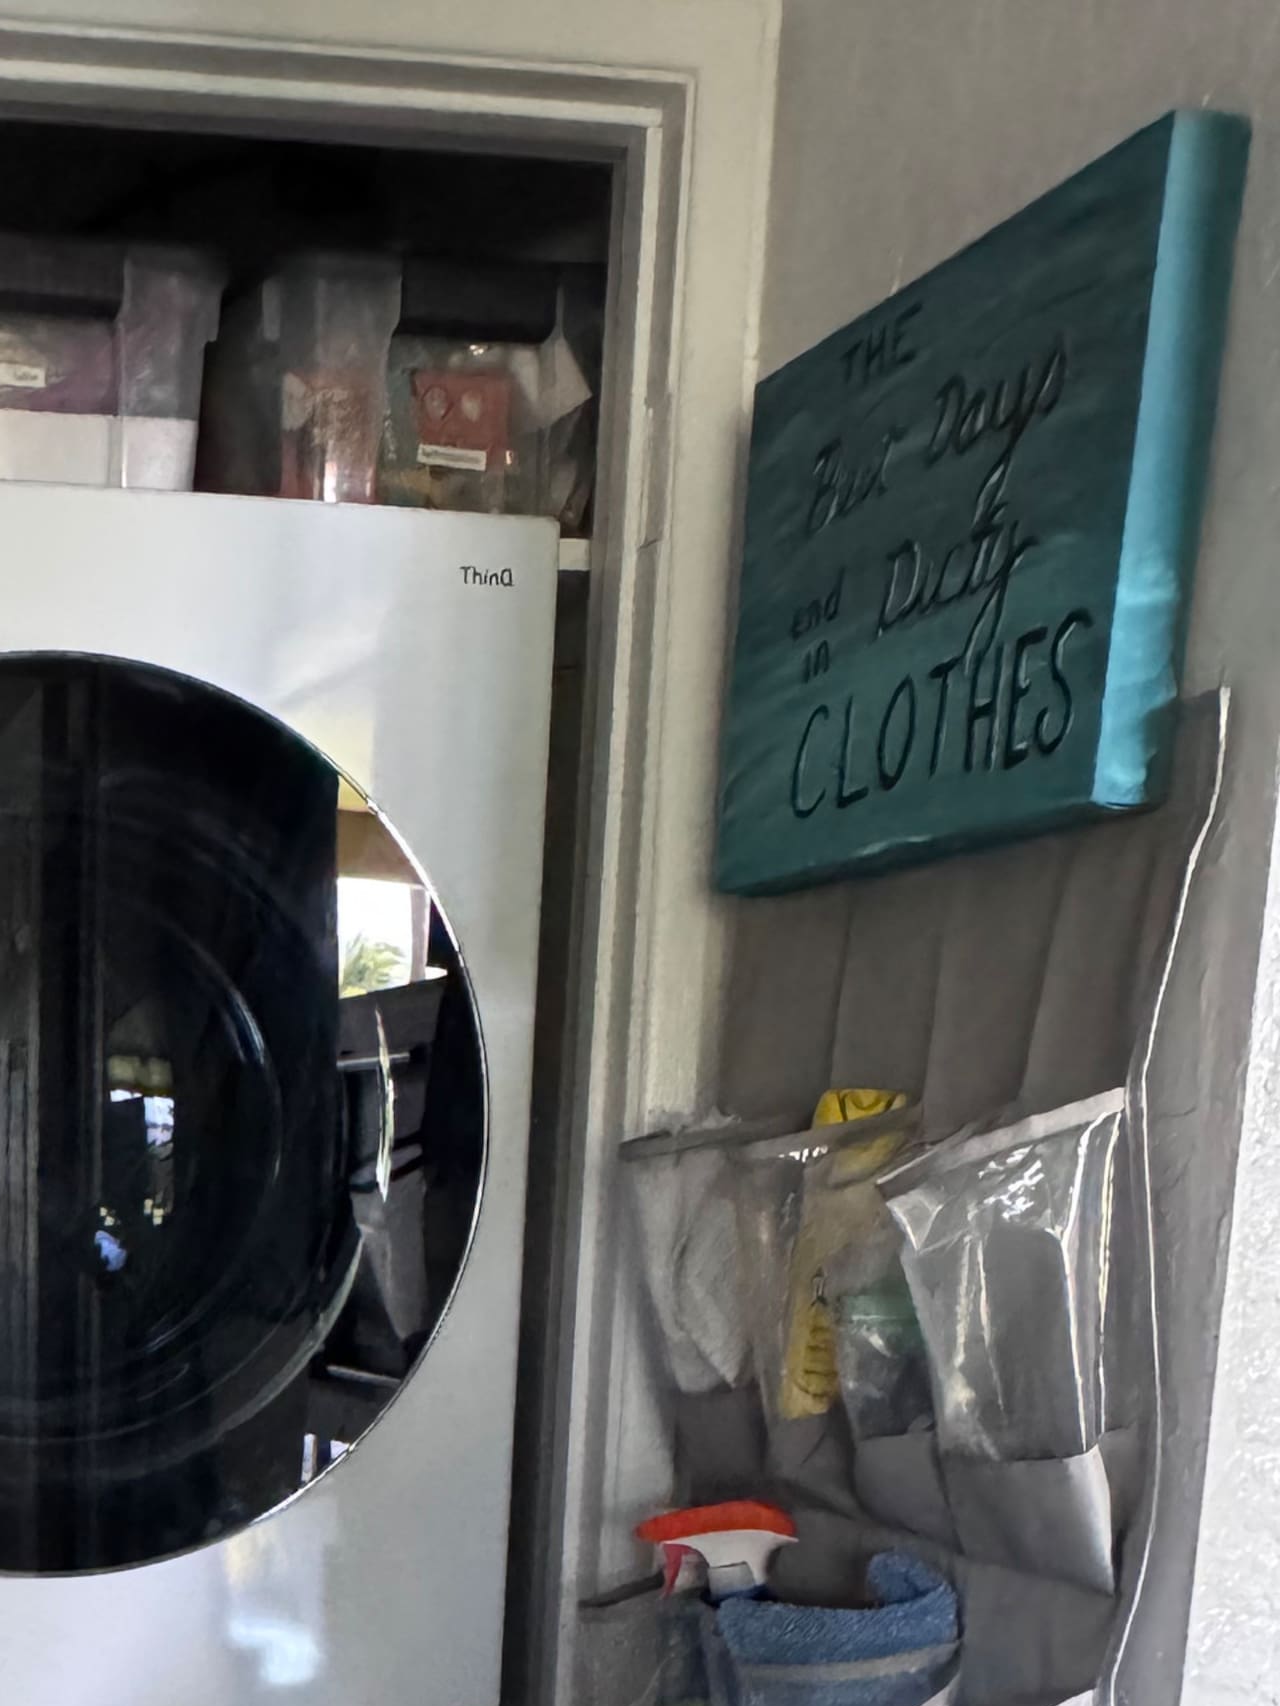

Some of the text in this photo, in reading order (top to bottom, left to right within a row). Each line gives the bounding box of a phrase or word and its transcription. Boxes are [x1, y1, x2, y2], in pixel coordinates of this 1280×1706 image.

[840, 302, 924, 384] THE
[923, 331, 1068, 531] Days
[460, 565, 515, 587] ThinQ
[791, 606, 1096, 820] CLOTHES
